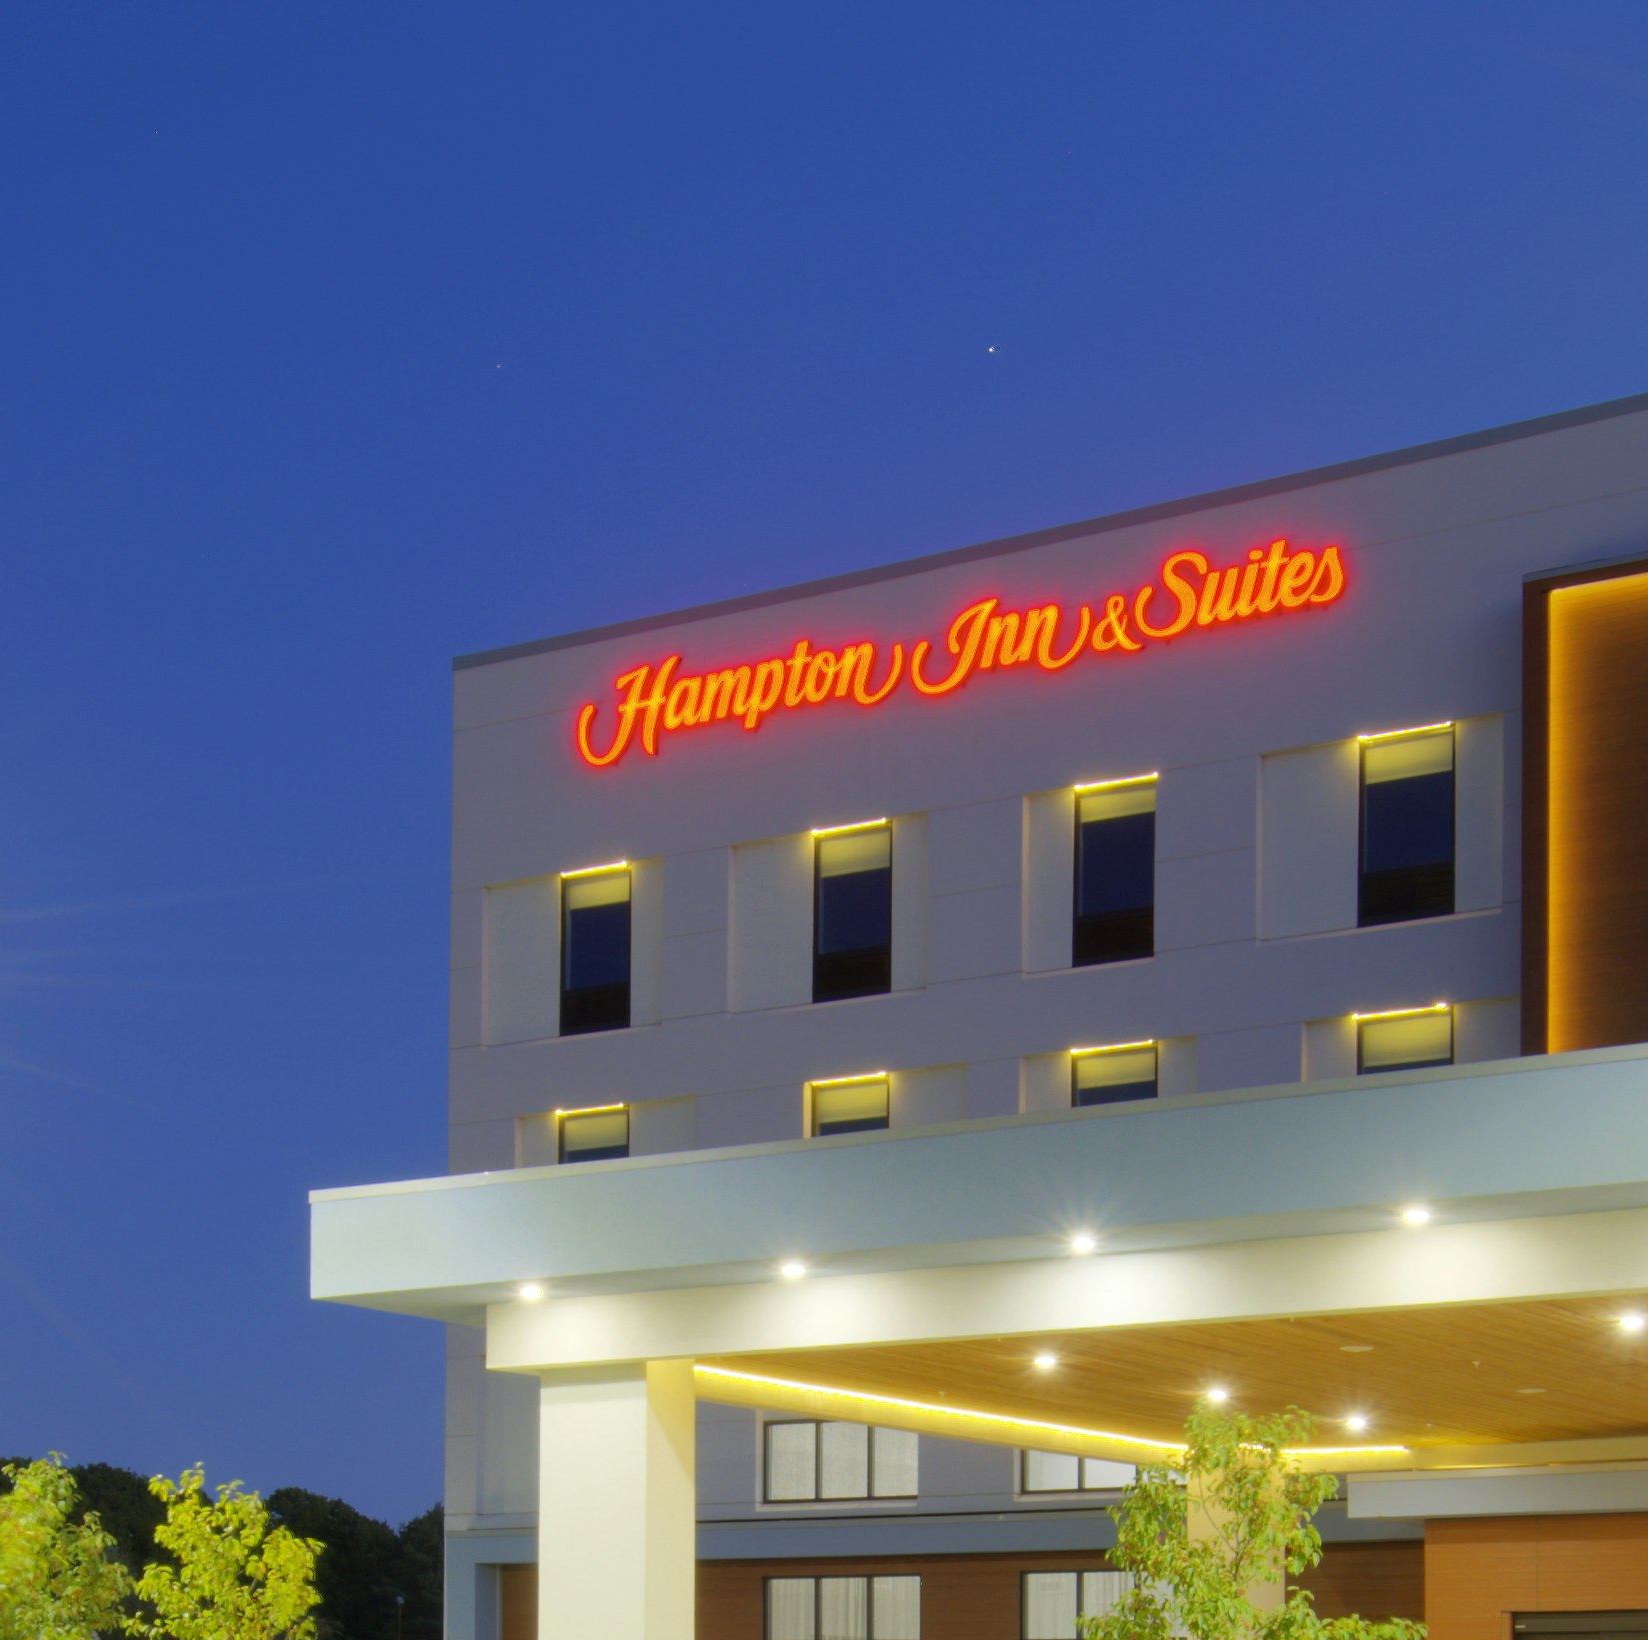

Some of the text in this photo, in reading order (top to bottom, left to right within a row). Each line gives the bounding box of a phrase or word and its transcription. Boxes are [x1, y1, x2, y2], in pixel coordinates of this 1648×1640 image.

[578, 538, 1344, 767] Hampton Inn & Suites
